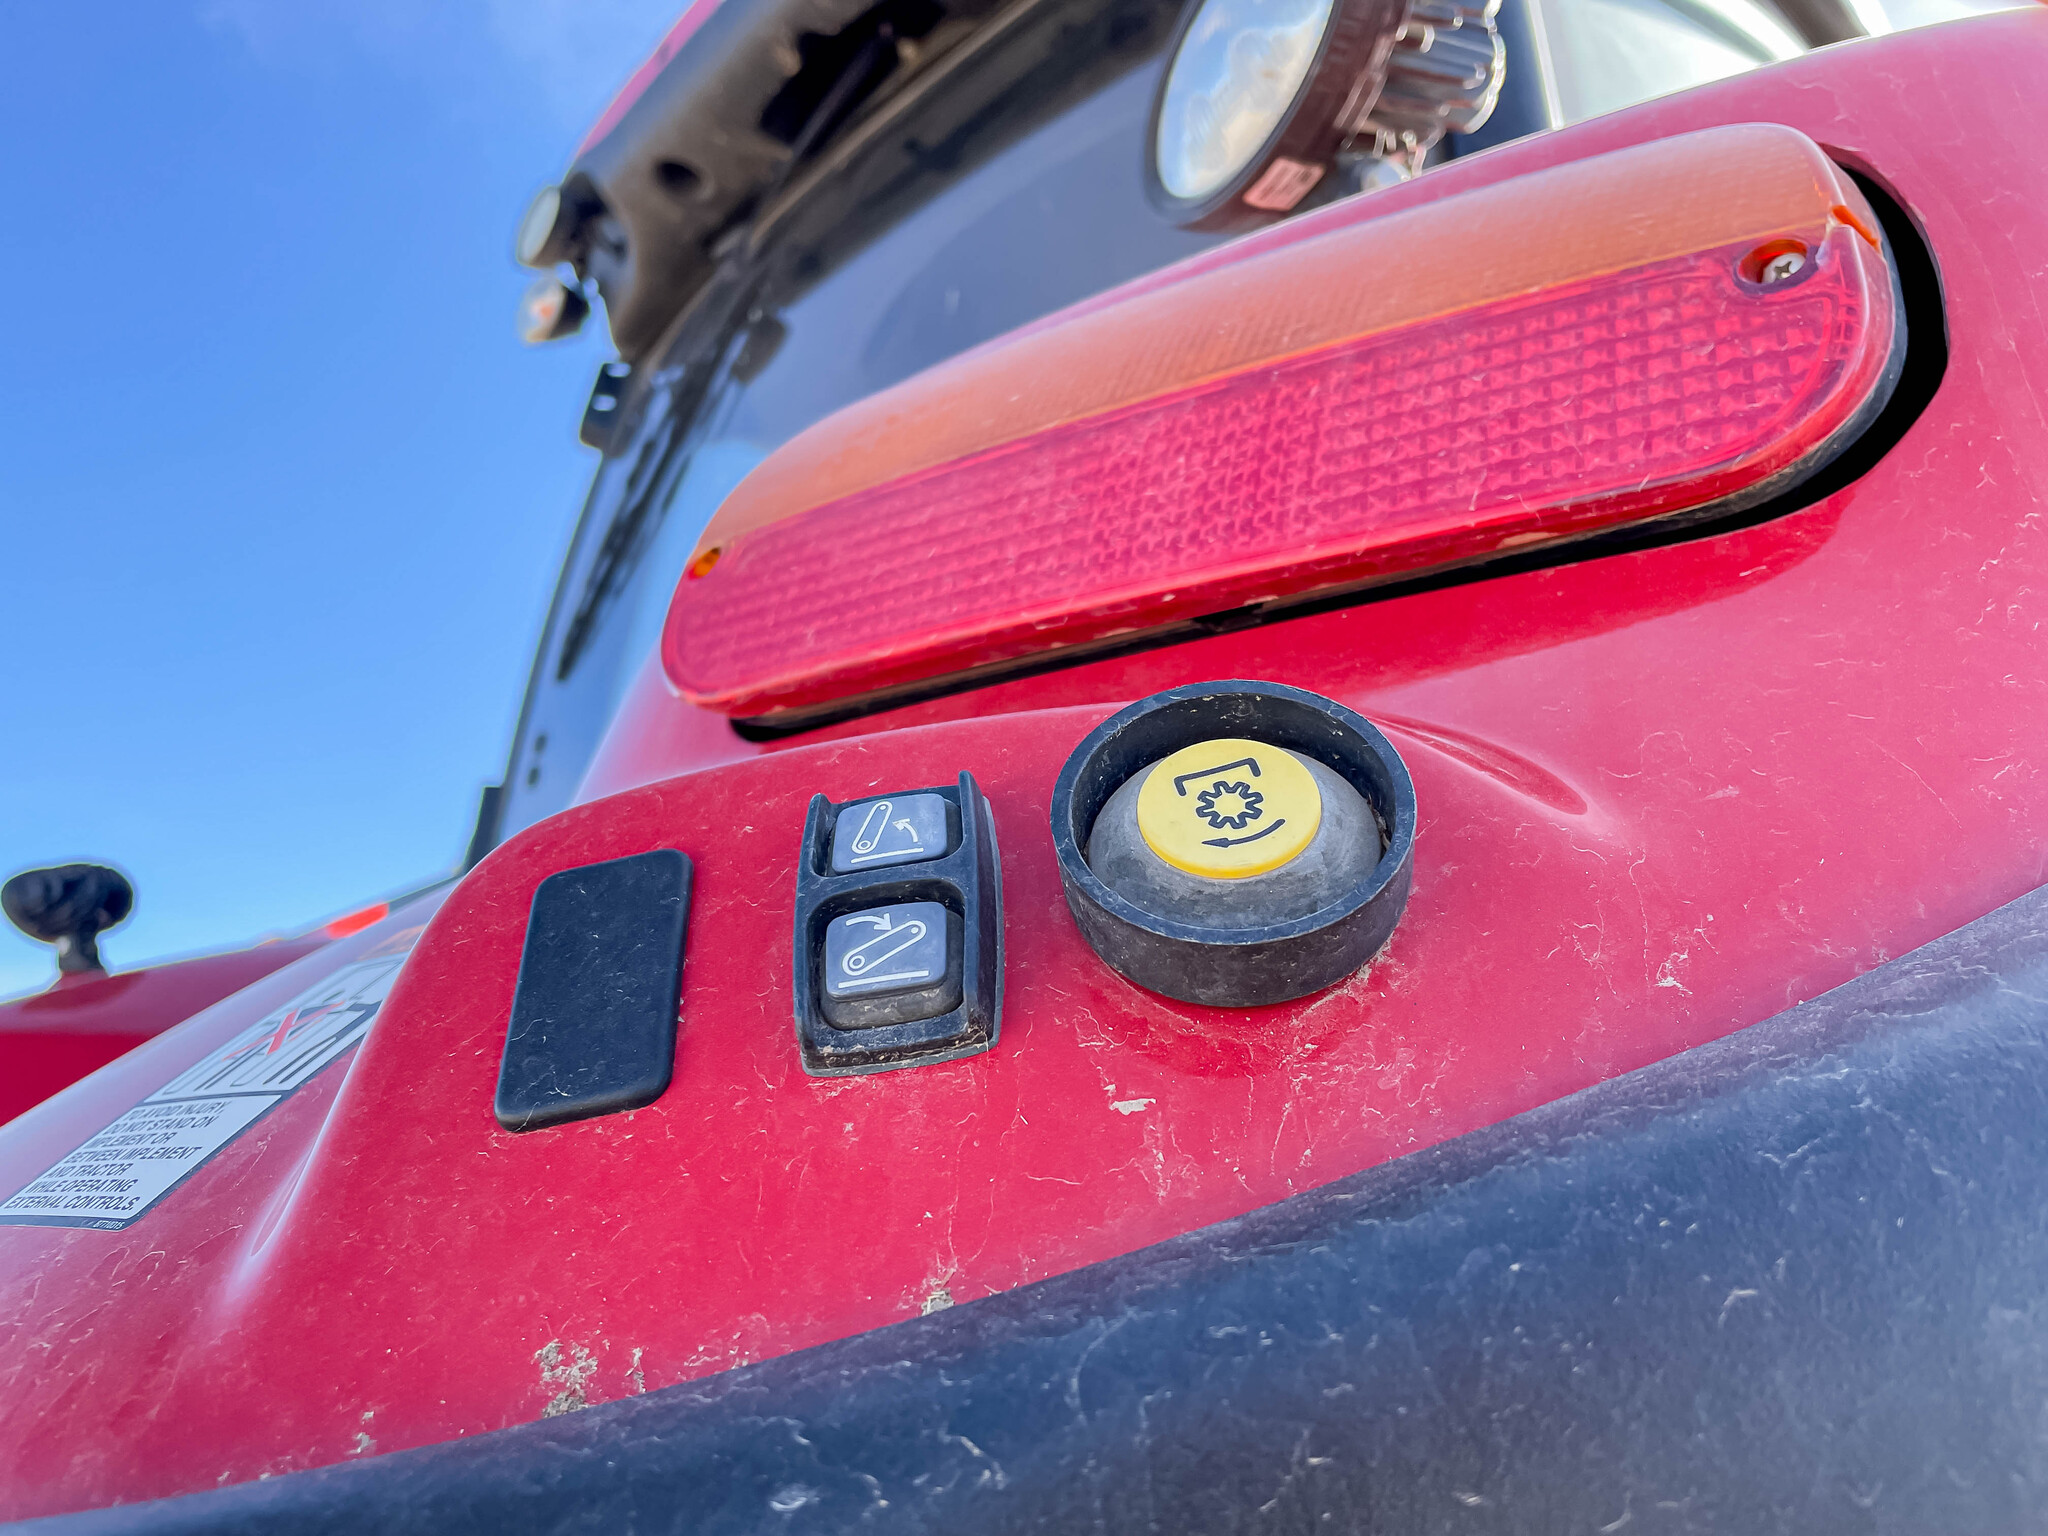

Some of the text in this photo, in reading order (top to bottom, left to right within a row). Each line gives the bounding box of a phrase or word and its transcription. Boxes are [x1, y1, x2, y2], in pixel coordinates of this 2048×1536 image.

[124, 1108, 146, 1120] TO
[142, 1104, 182, 1118] AVOID
[103, 1115, 219, 1134] DO NOT STAND ON
[83, 1131, 177, 1149] IMPLEMENT OR
[63, 1146, 202, 1164] BETWEEN IMPLEMENT
[43, 1163, 134, 1178] AND TRACTOR
[25, 1178, 139, 1193] WHILE OPERATING
[4, 1195, 140, 1211] EXTERNAL CONTROLS.
